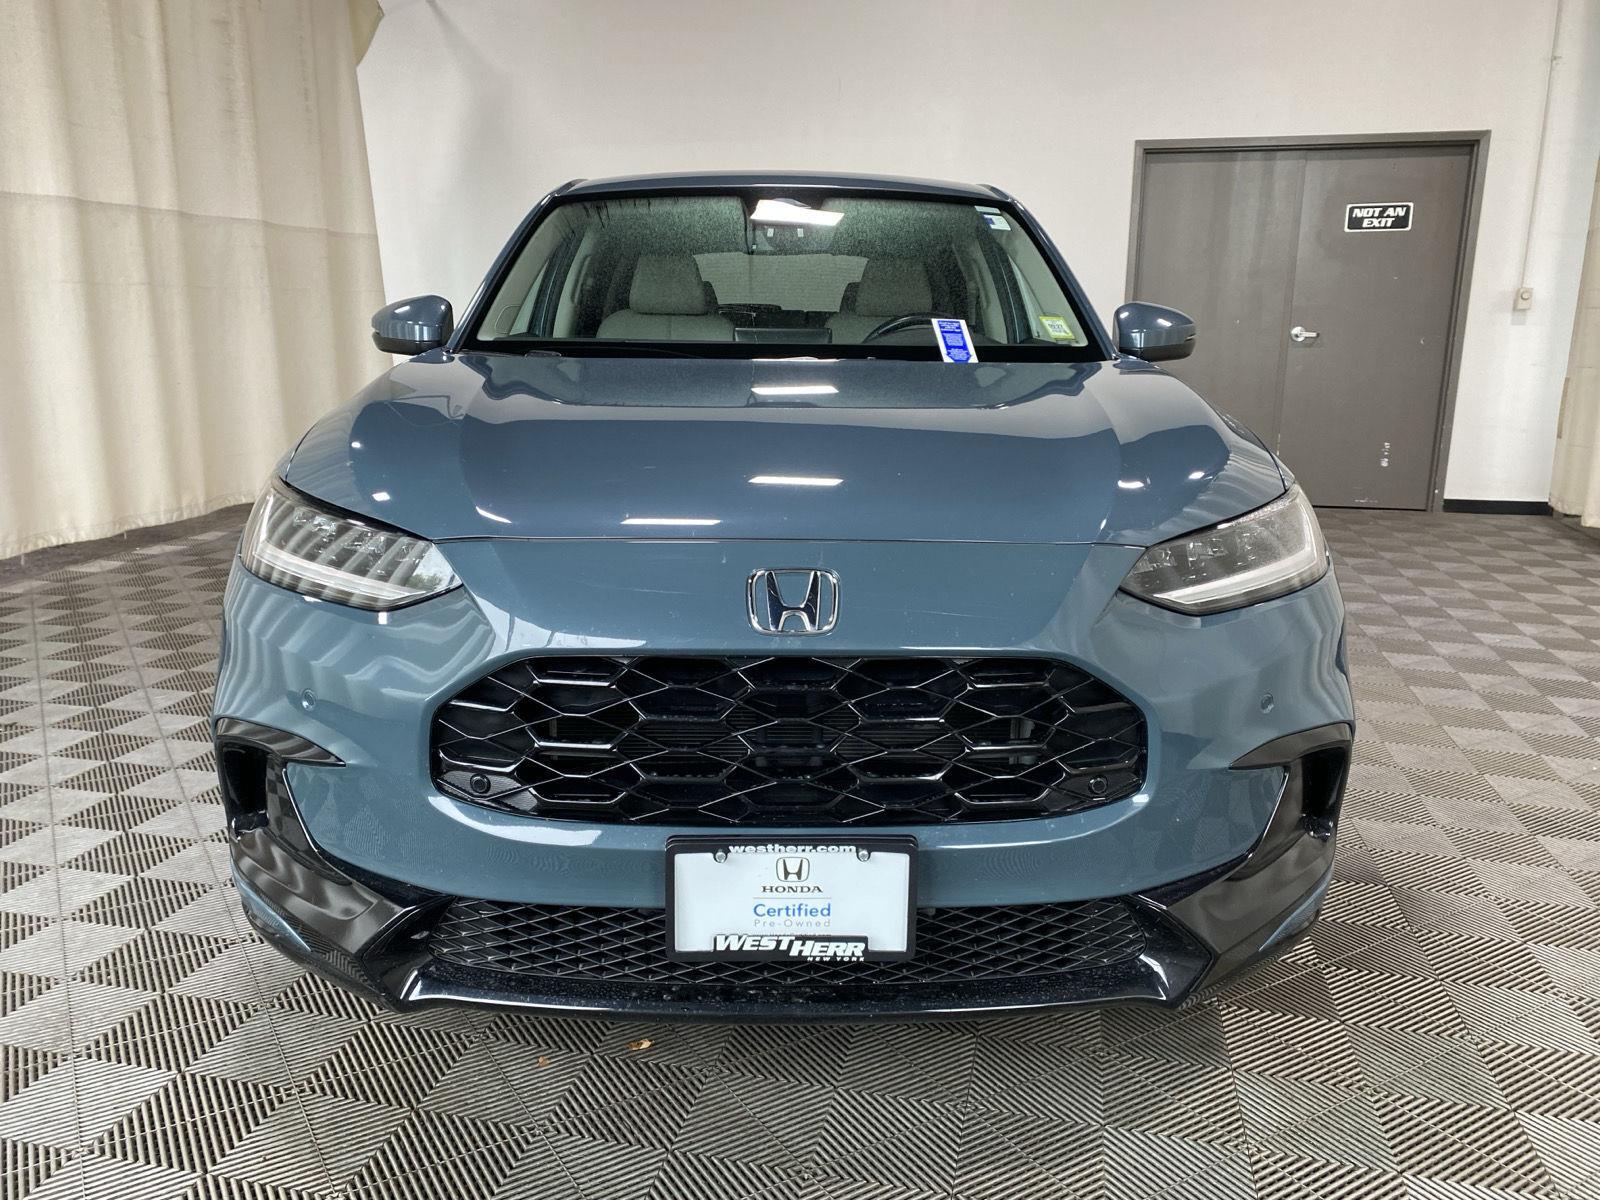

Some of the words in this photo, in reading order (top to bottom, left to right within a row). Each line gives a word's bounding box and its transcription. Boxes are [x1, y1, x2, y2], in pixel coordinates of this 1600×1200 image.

[1352, 207, 1383, 218] NOT
[1383, 206, 1407, 217] AN
[1362, 218, 1395, 228] EXIT
[728, 844, 857, 853] westherr.com
[761, 885, 823, 894] HONDA
[753, 902, 831, 918] Certified
[753, 918, 831, 929] Pre-Owned
